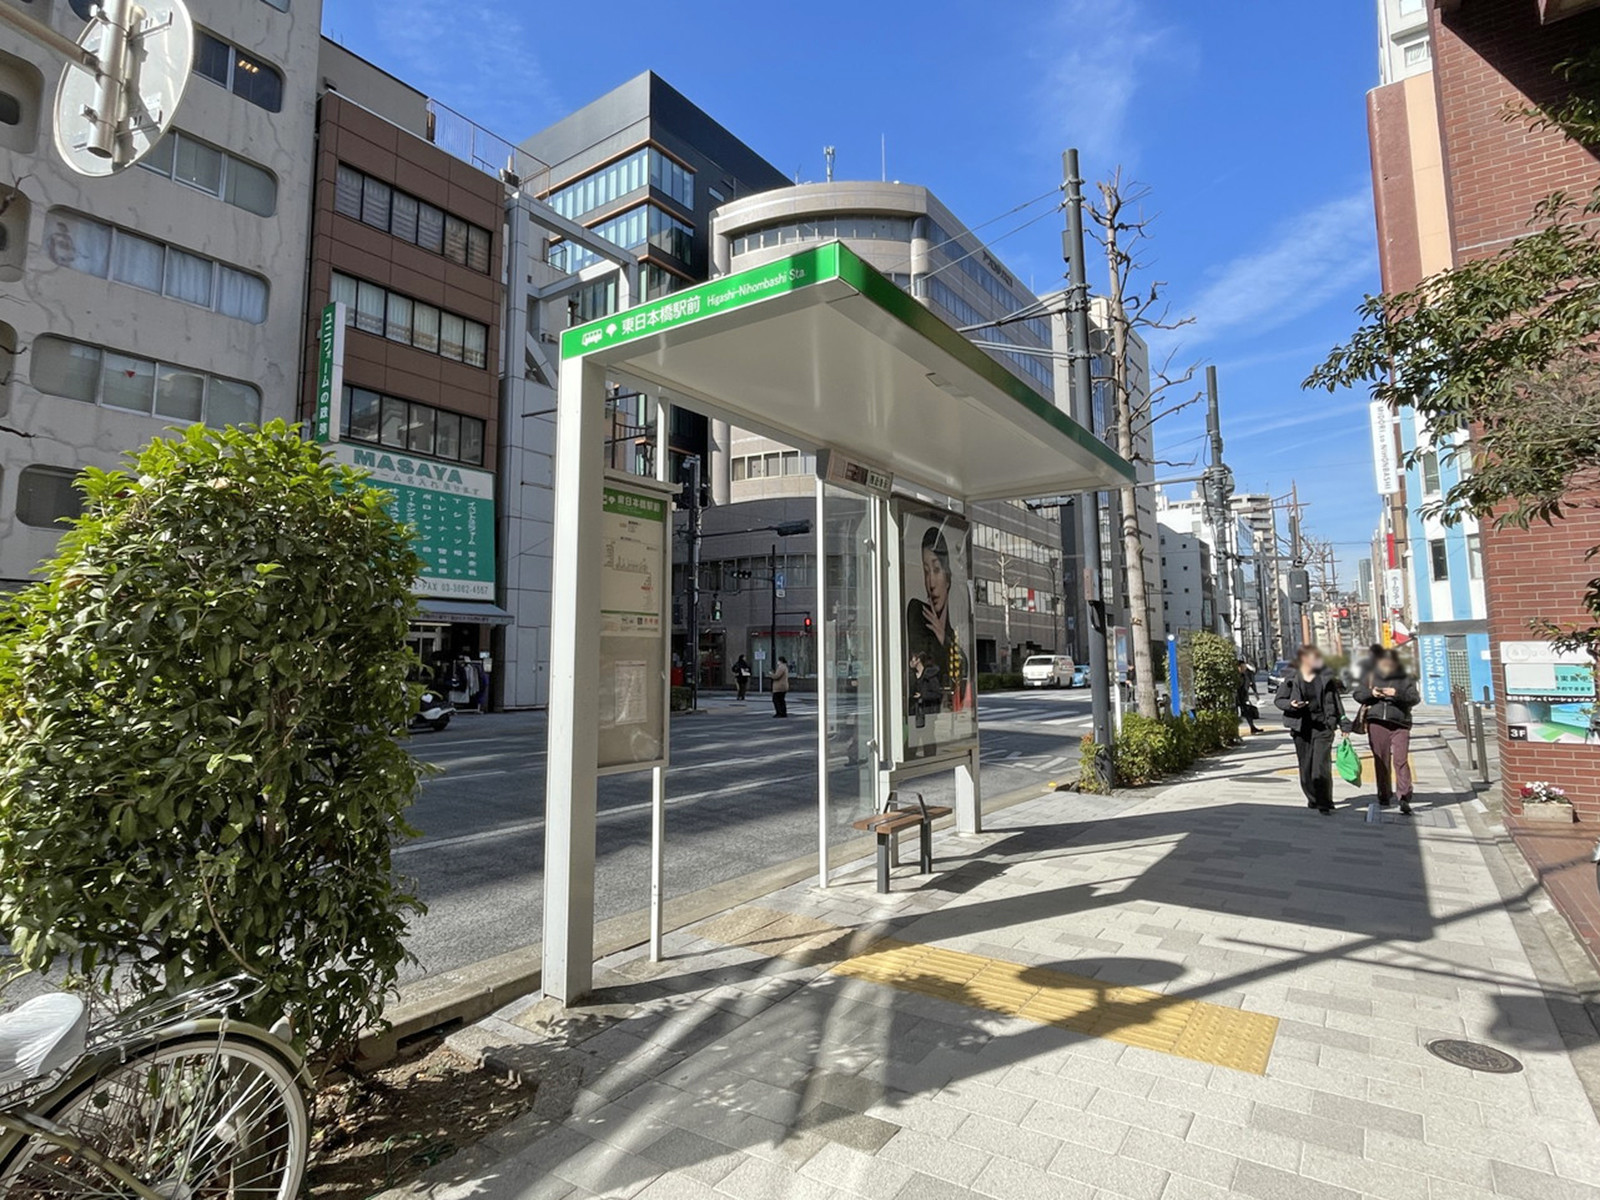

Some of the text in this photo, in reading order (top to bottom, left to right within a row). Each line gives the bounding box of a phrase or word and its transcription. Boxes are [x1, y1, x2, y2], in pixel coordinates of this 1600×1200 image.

[706, 271, 787, 308] Higashi-Nihombashi
[621, 295, 701, 335] 東日本橋駅前
[353, 449, 463, 485] MASAYA
[1510, 729, 1526, 738] 3F
